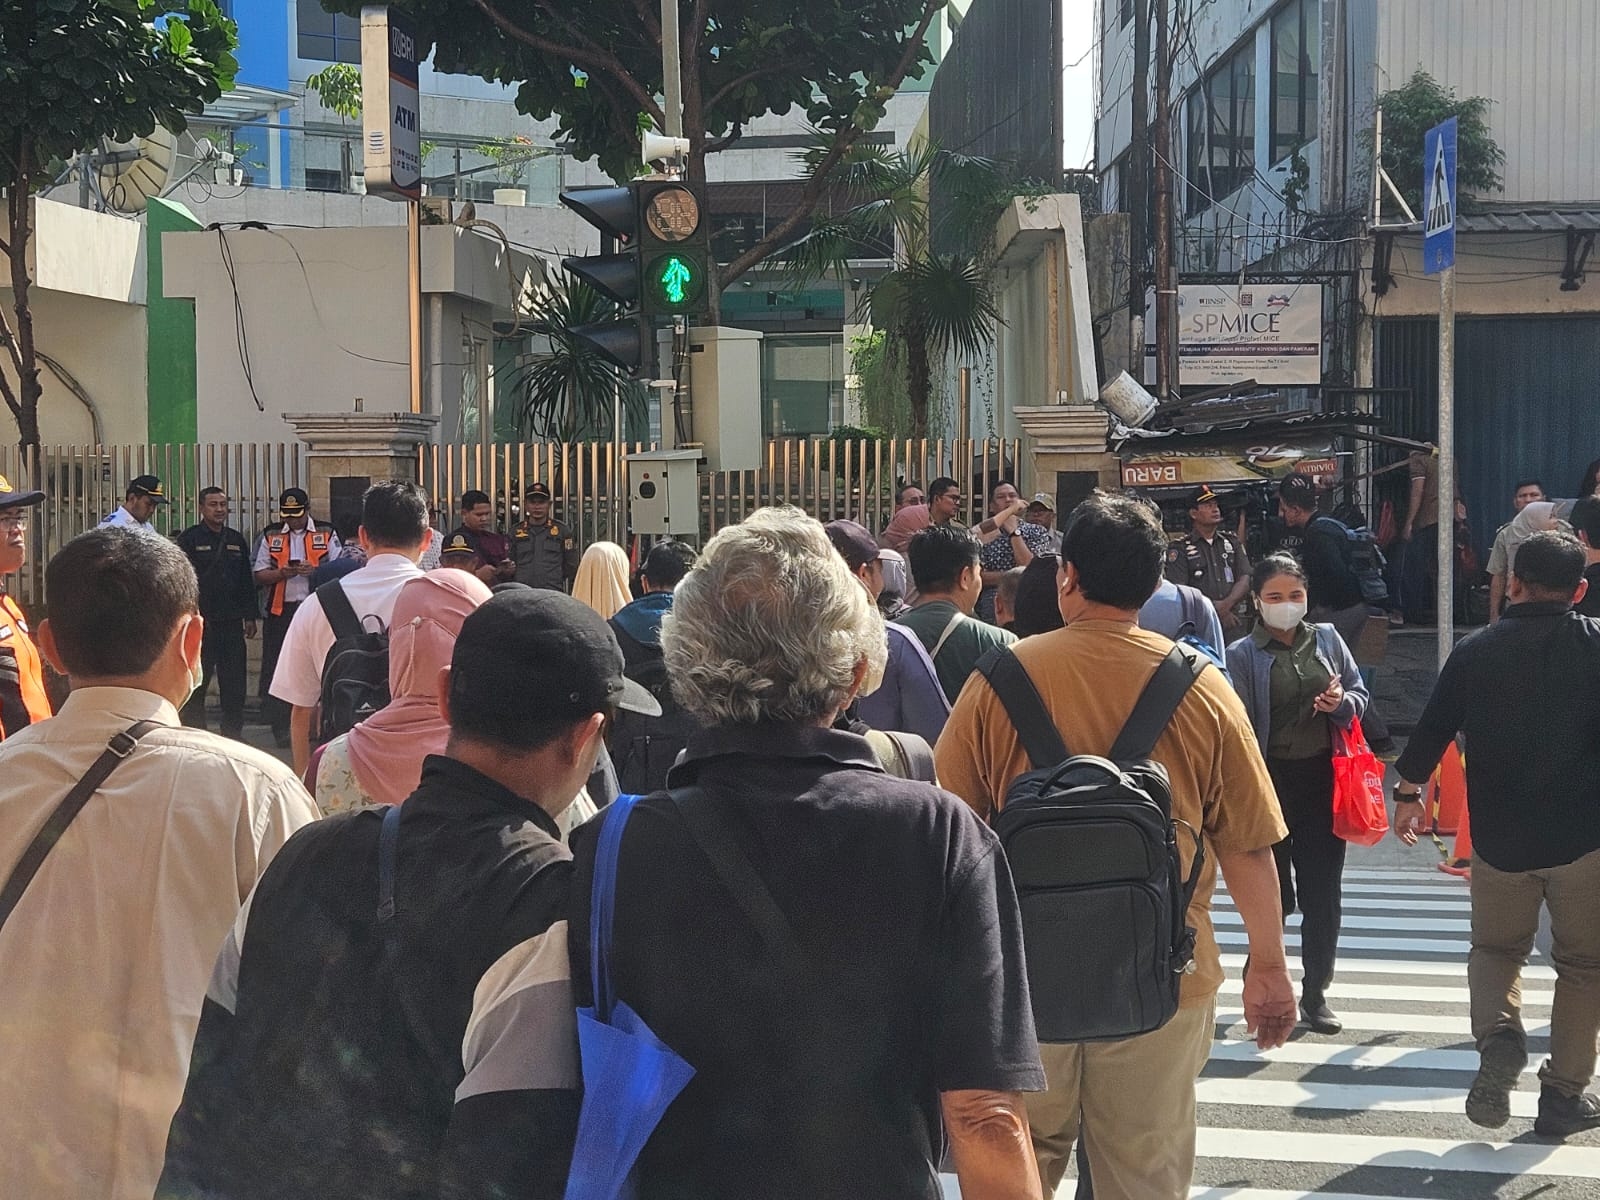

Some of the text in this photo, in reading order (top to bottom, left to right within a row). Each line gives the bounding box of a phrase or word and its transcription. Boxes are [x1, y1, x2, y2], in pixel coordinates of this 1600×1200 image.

[400, 32, 415, 63] BRI
[394, 105, 416, 133] ATM
[1193, 312, 1281, 333] SPMICE
[1124, 465, 1177, 483] BARU
